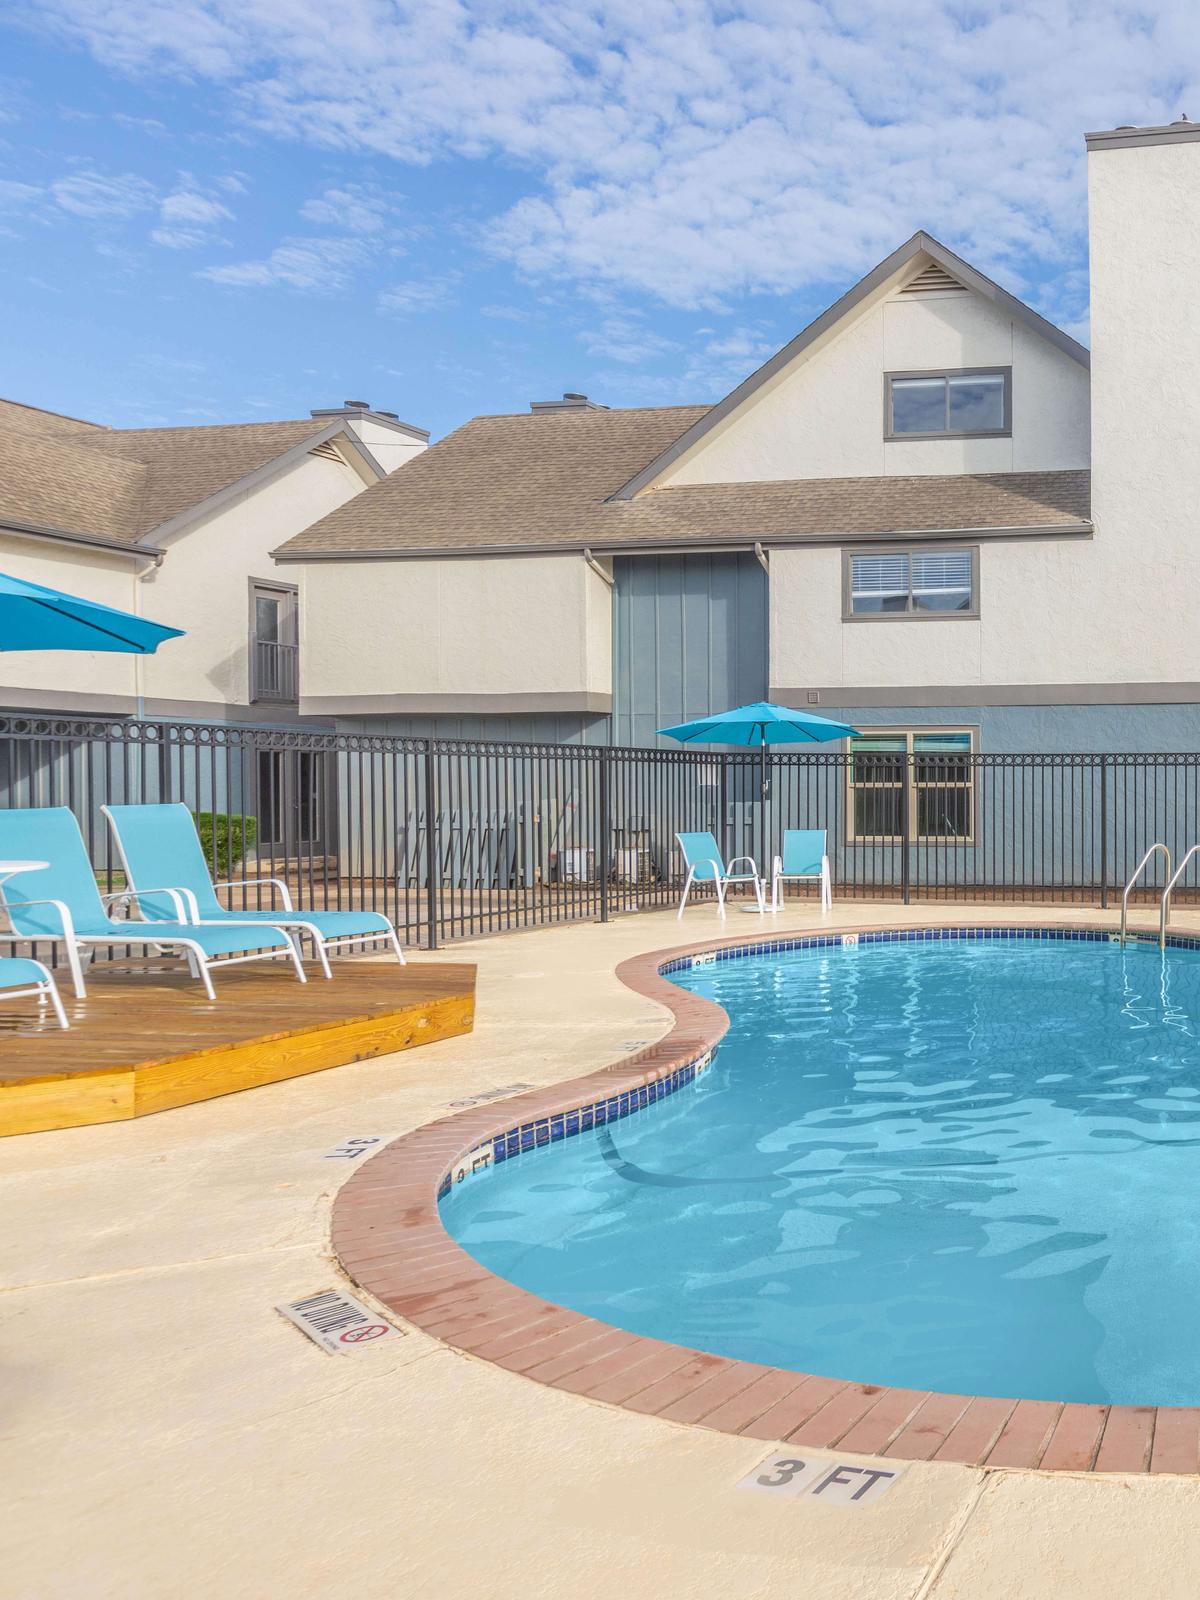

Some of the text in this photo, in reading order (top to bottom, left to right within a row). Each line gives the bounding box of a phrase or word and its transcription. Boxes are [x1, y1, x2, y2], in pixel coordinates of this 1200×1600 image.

[323, 1147, 368, 1159] FT
[288, 1292, 368, 1333] NO DIVING
[756, 1459, 895, 1501] 3 FT
